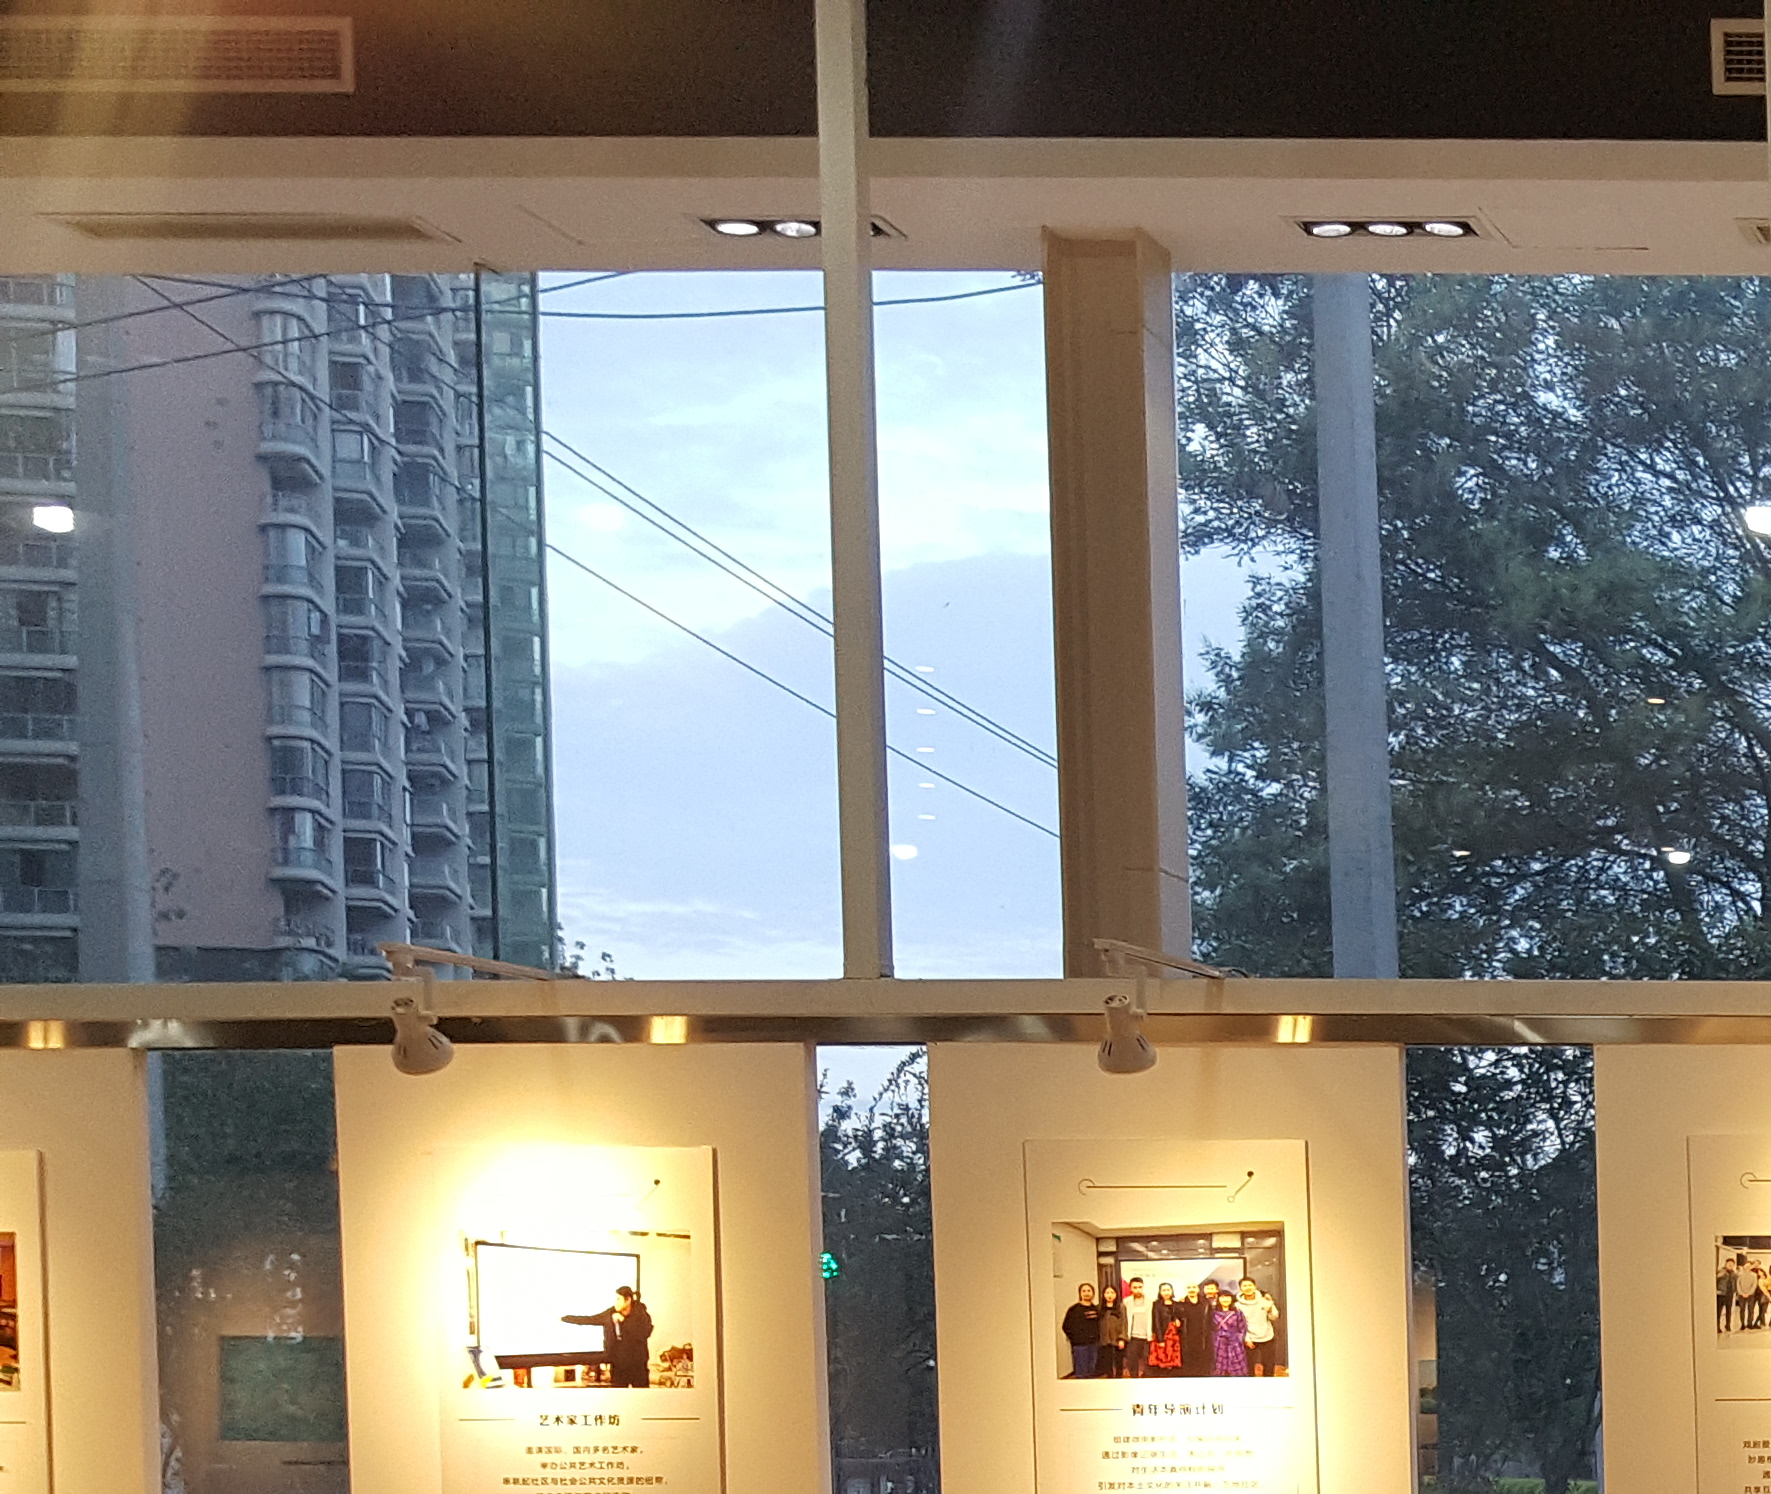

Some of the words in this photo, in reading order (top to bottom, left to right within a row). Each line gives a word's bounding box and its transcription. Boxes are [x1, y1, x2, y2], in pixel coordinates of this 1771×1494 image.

[539, 1414, 620, 1427] 艺术家工作坊
